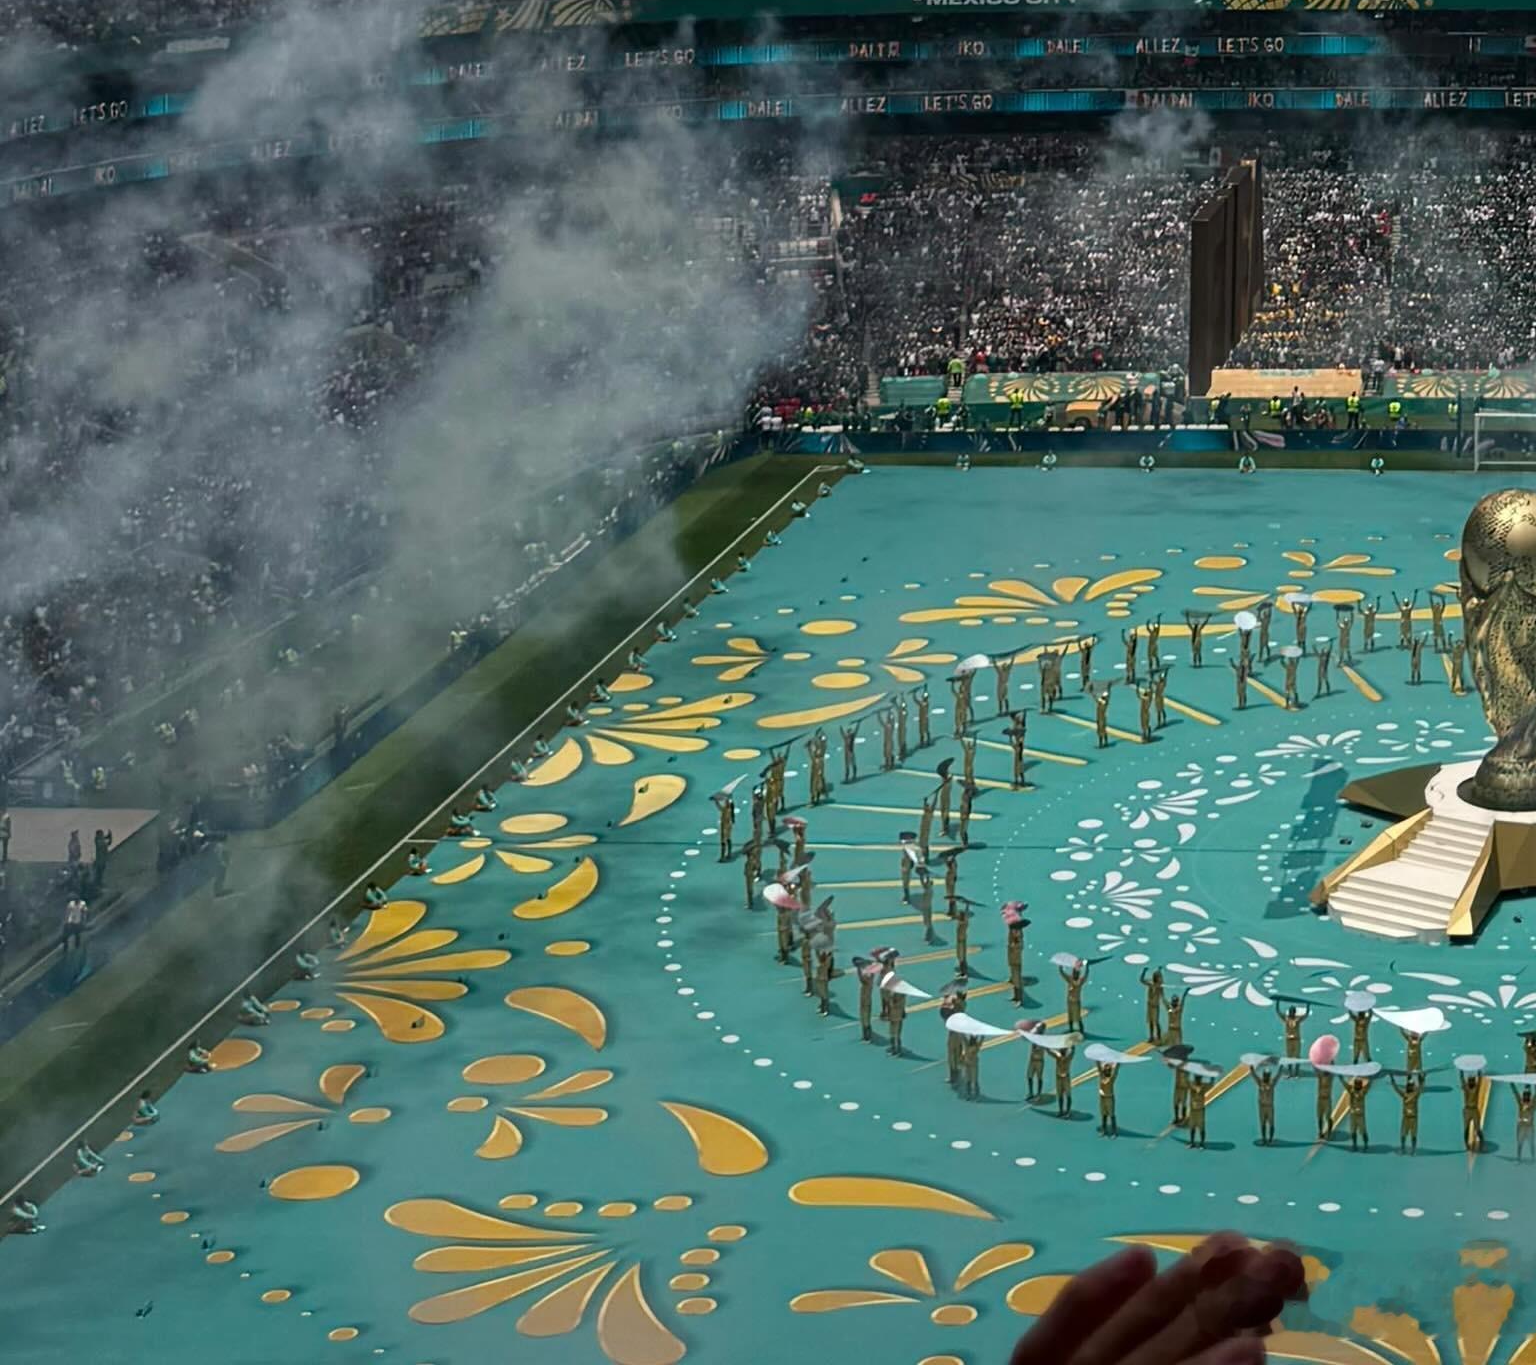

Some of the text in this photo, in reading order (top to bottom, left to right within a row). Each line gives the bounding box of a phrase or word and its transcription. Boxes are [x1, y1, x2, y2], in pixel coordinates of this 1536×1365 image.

[959, 40, 985, 56] IKO
[1047, 38, 1081, 54] DALE
[1136, 38, 1180, 54] ALLEZ
[1218, 37, 1259, 53] LET'S
[1263, 37, 1284, 53] GO
[925, 94, 967, 111] LET'S
[972, 94, 992, 110] GO
[1248, 92, 1274, 108] IKO
[1336, 91, 1369, 108] DALE
[1424, 92, 1467, 108] ALLEZ
